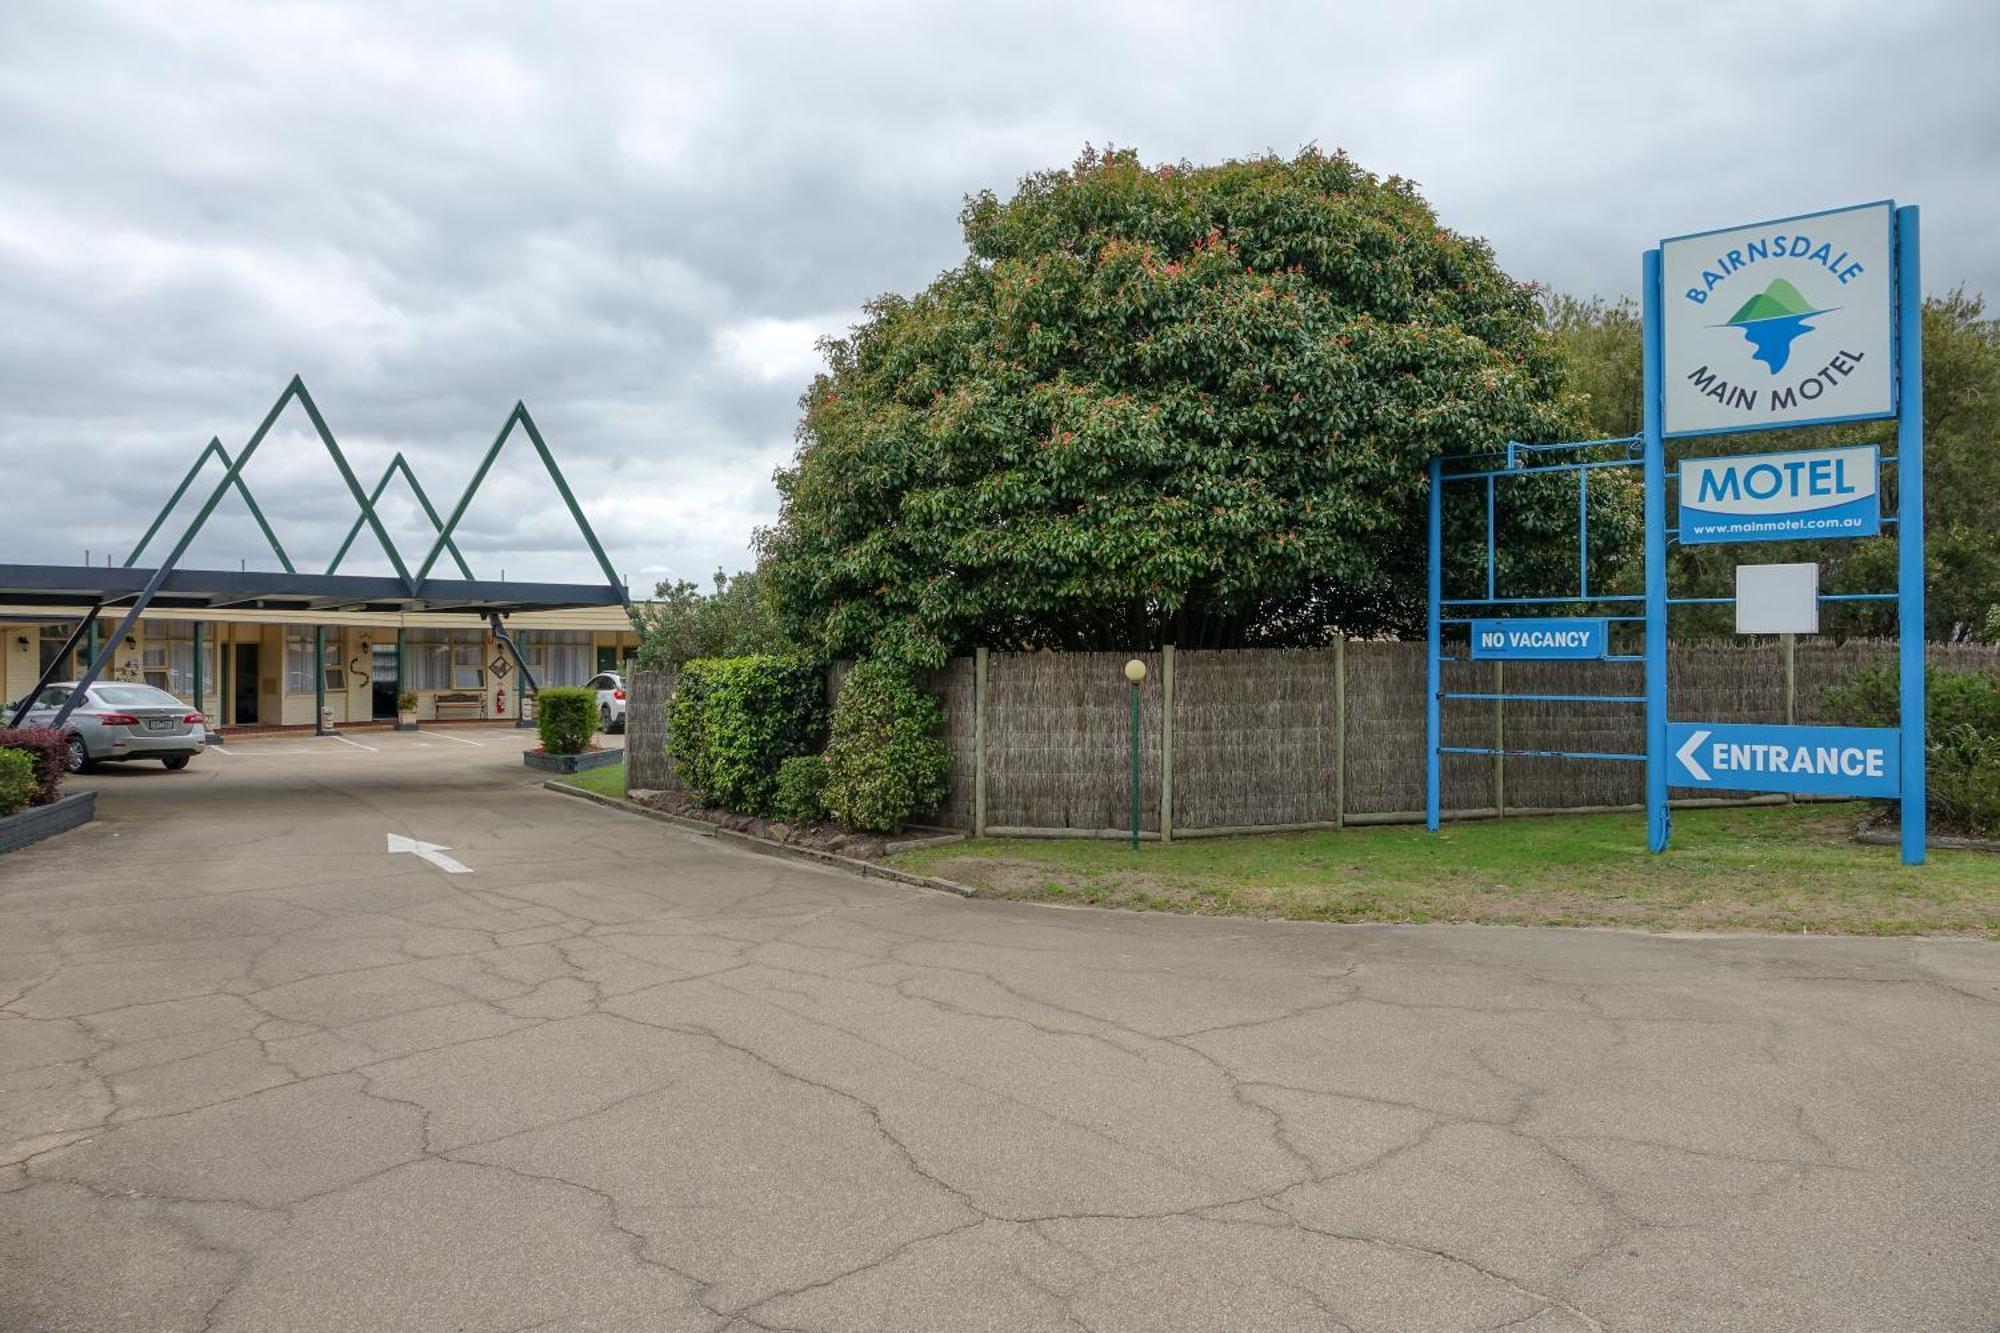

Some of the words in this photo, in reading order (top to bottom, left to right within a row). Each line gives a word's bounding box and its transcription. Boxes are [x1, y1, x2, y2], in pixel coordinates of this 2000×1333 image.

[1685, 235, 1864, 305] BAIRNSDALE
[1687, 365, 1757, 411] MAIN
[1770, 350, 1865, 412] MOTEL
[1698, 458, 1855, 503] MOTEL
[1694, 517, 1863, 534] www.mainmotel.com.au
[1481, 632, 1504, 648] NO
[1509, 631, 1590, 648] VACANCY
[1712, 743, 1884, 777] ENTRANCE
